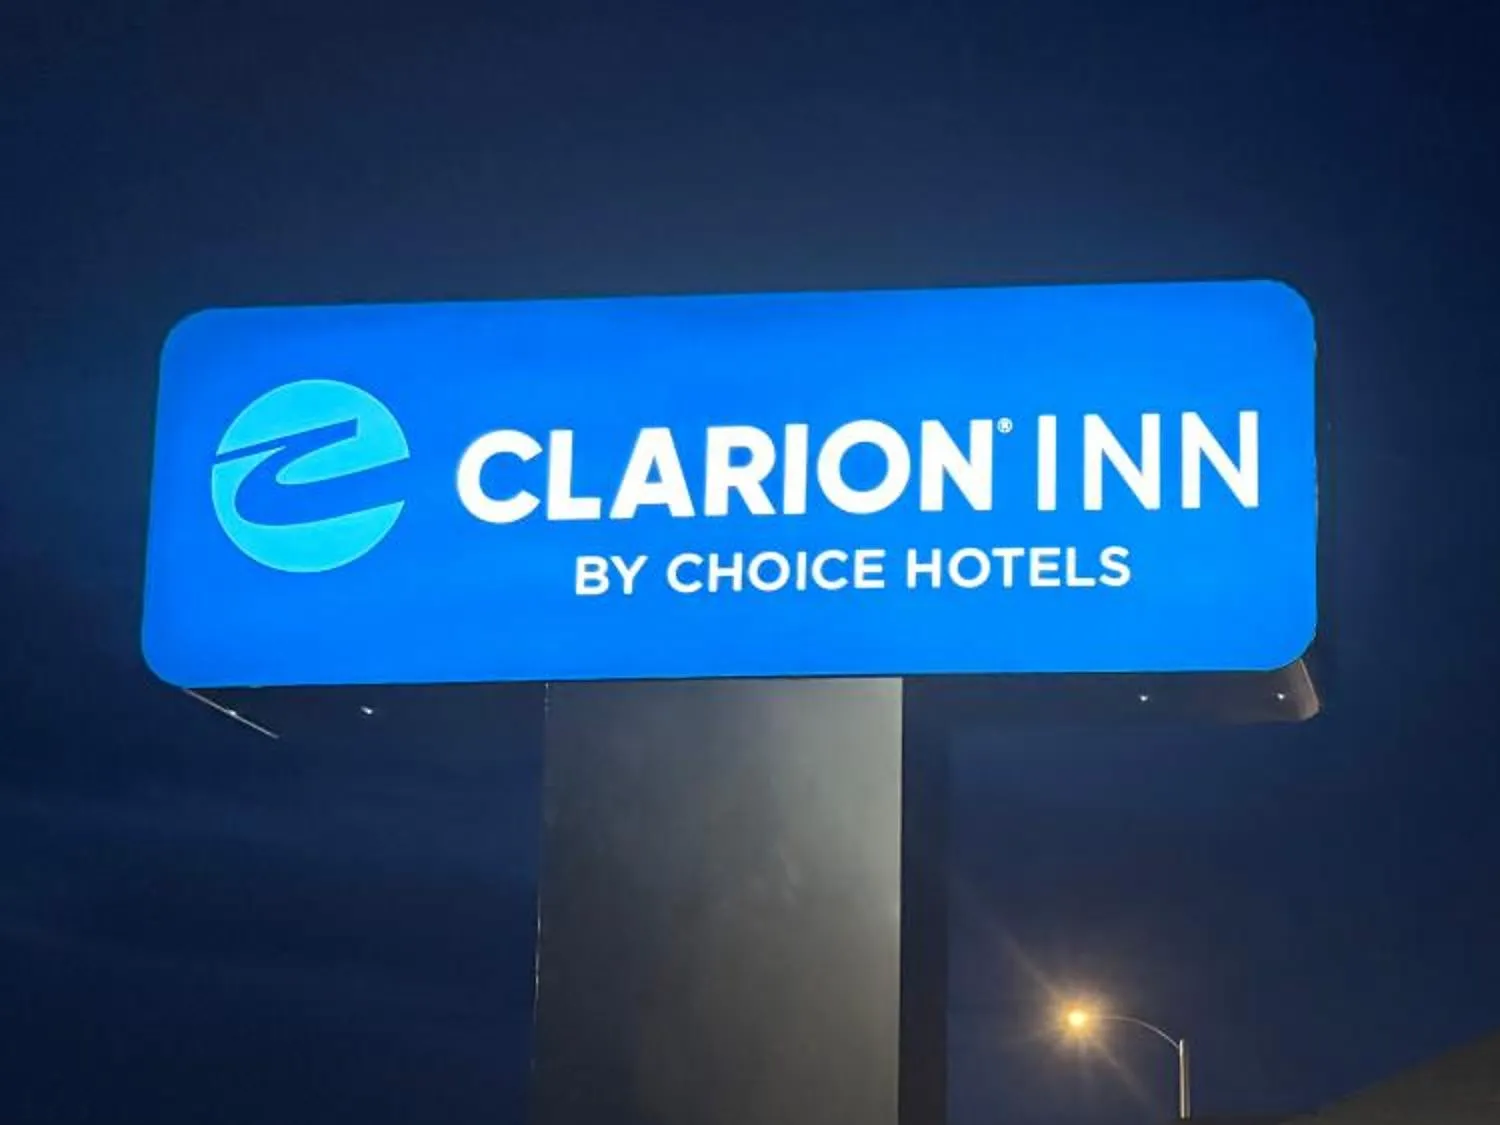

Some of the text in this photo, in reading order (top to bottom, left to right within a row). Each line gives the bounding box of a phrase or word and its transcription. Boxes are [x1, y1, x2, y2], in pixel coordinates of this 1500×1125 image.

[1038, 411, 1259, 511] INN
[575, 546, 1132, 595] BY CHOICE HOTELS
